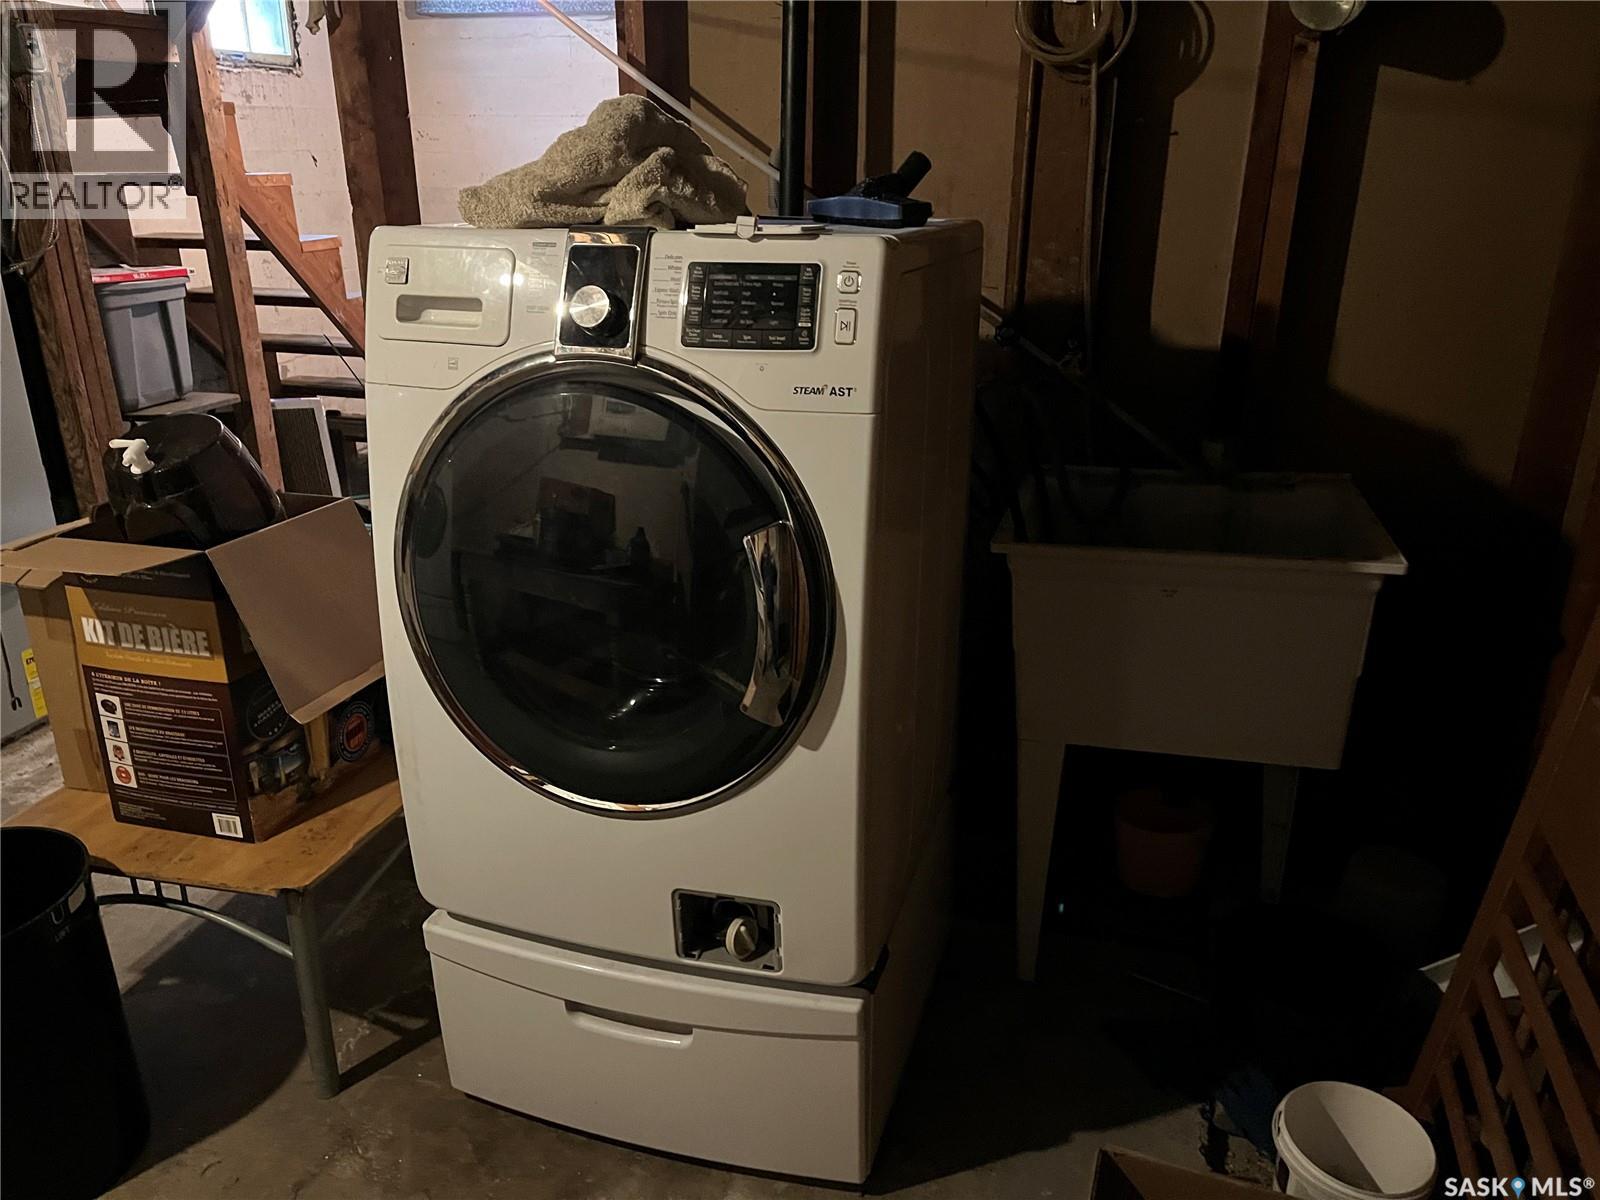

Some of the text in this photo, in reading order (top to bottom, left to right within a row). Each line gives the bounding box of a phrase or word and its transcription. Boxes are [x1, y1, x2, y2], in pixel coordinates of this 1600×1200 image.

[792, 386, 825, 396] STEAM
[80, 616, 116, 647] KIT
[117, 621, 147, 651] DE
[146, 622, 212, 658] BIÈRE
